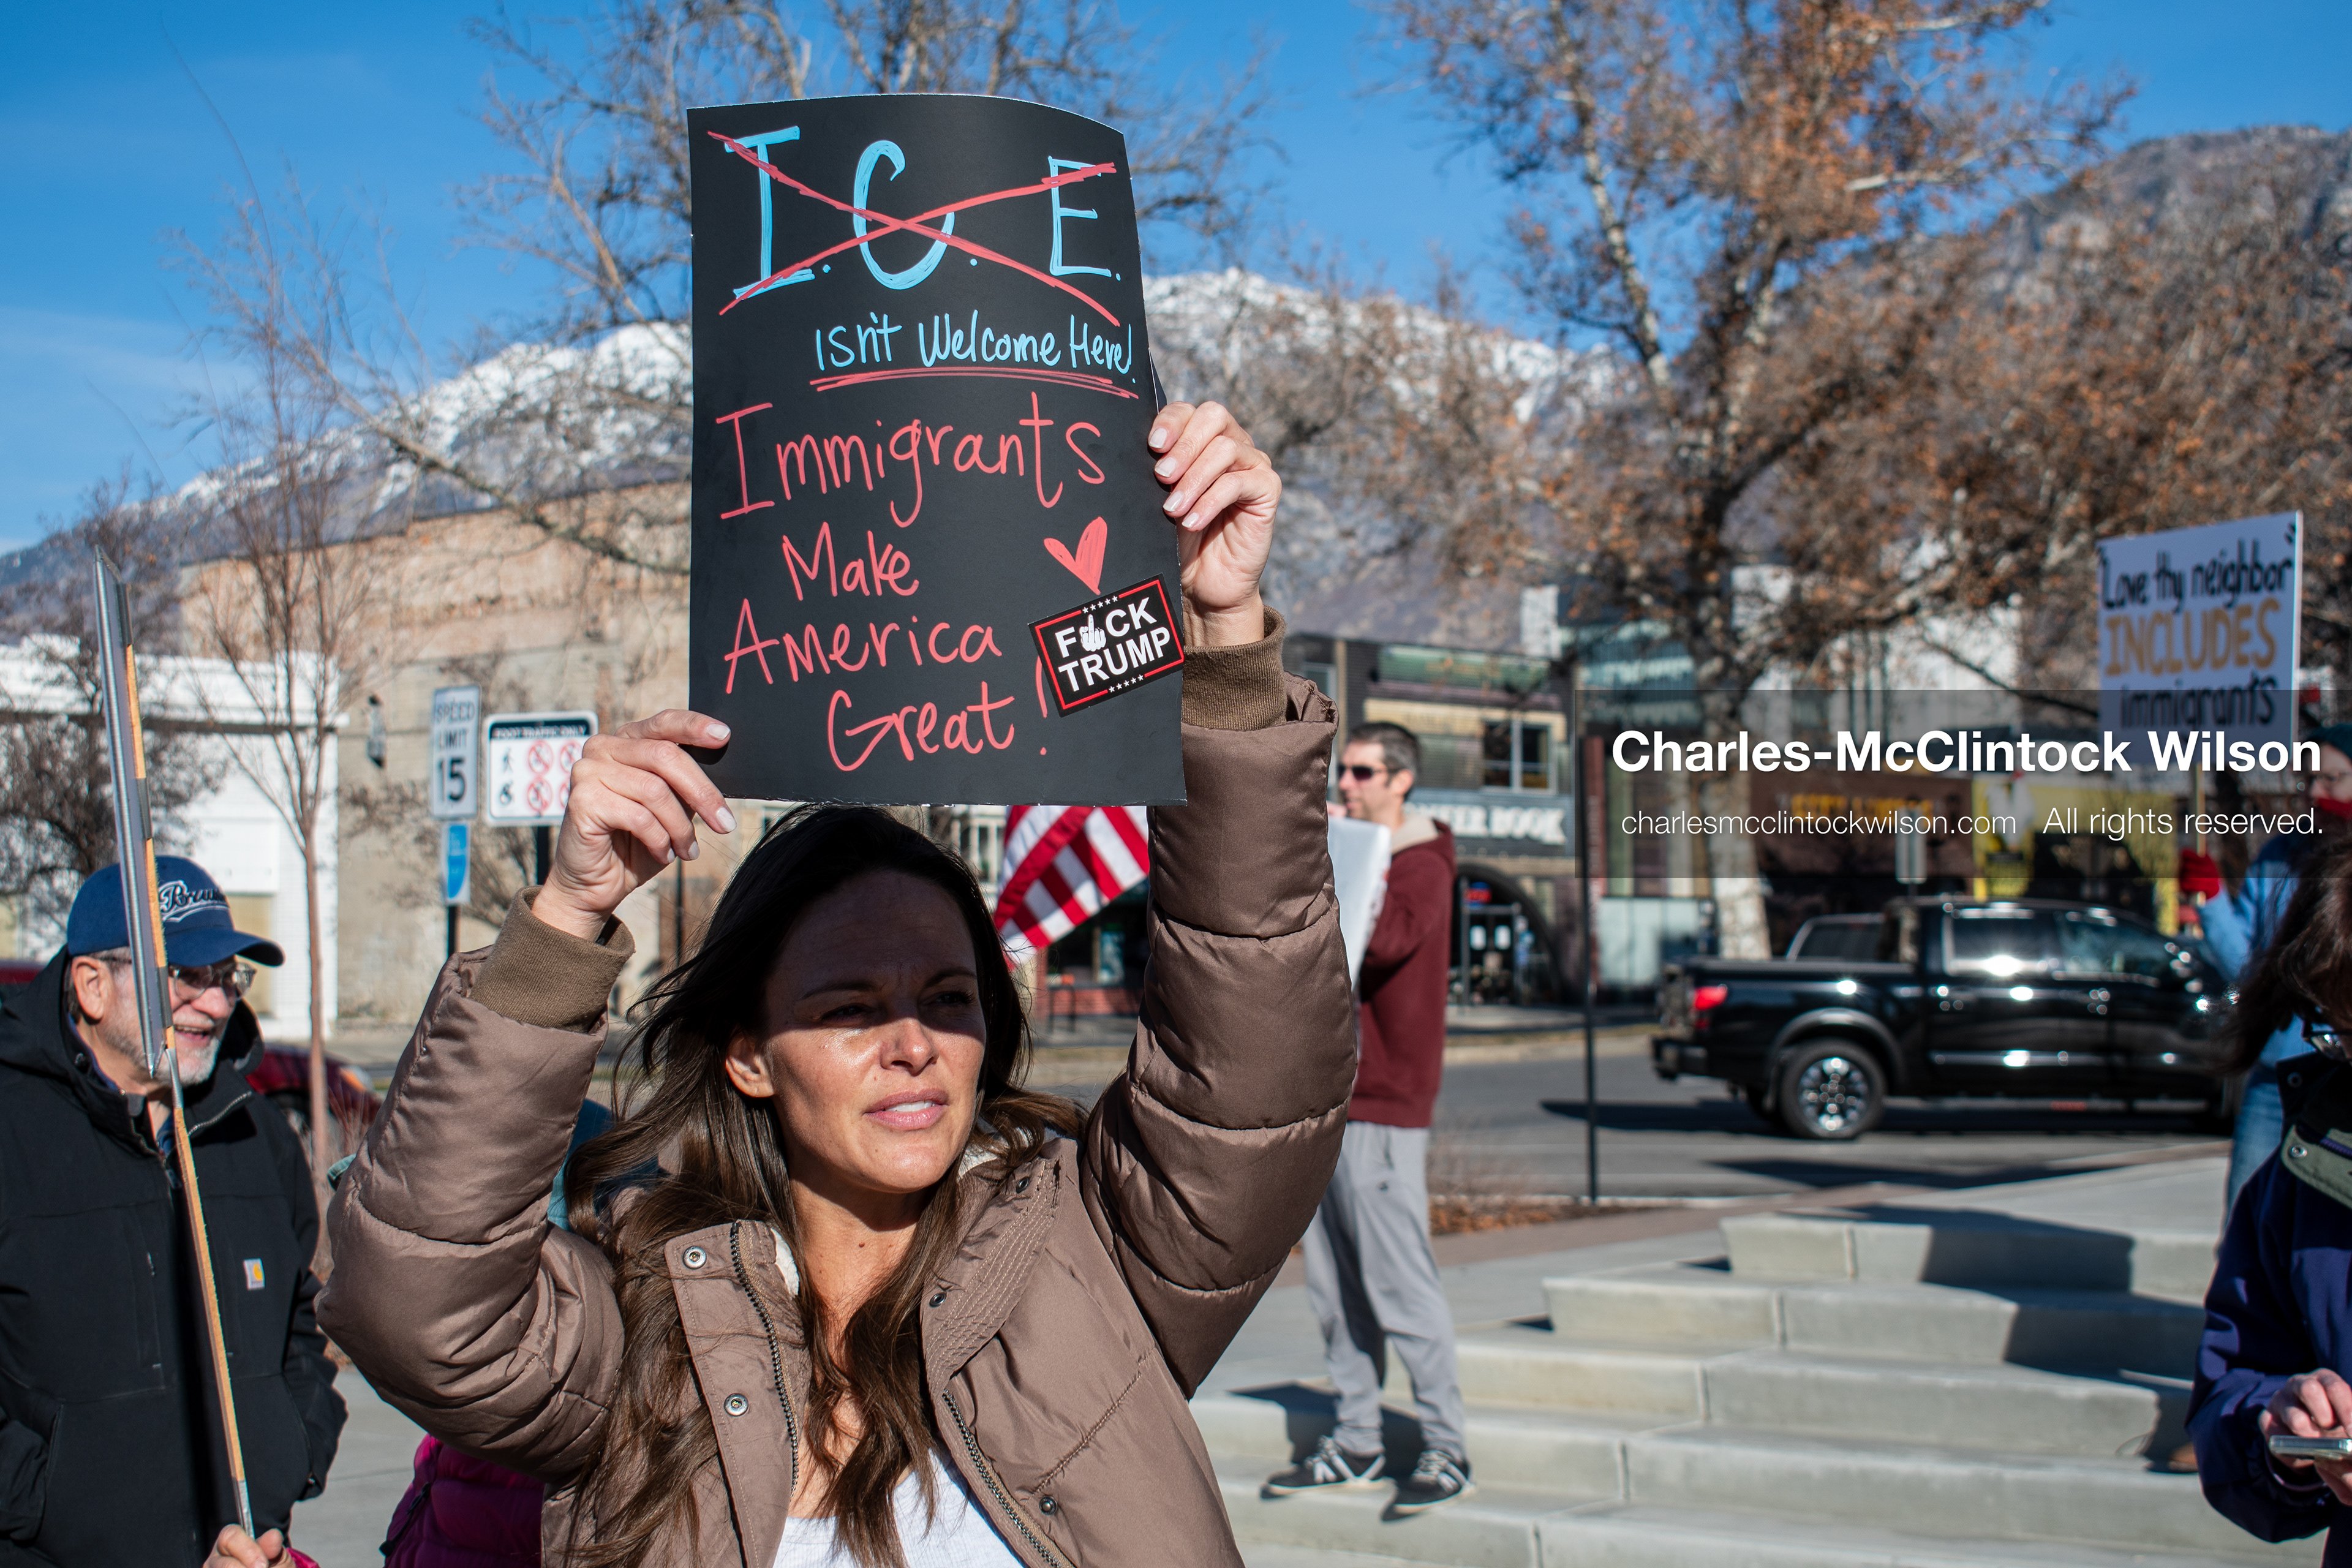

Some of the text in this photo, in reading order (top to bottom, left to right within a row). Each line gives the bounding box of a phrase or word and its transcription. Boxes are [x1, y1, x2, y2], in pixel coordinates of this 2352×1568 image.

[918, 309, 1061, 368] Welcome
[1069, 314, 1136, 383] Here!
[717, 391, 1106, 528] Immigrants
[782, 522, 919, 601] Make
[2154, 551, 2185, 615] thy
[724, 598, 1003, 694] America
[1058, 627, 1171, 692] TRUMP
[2105, 597, 2280, 677] INCLUDES
[435, 701, 475, 724] SPEED
[439, 729, 469, 749] LIMIT
[492, 724, 586, 739] FOOT TRAFFIC ONLY
[439, 756, 467, 802] 15
